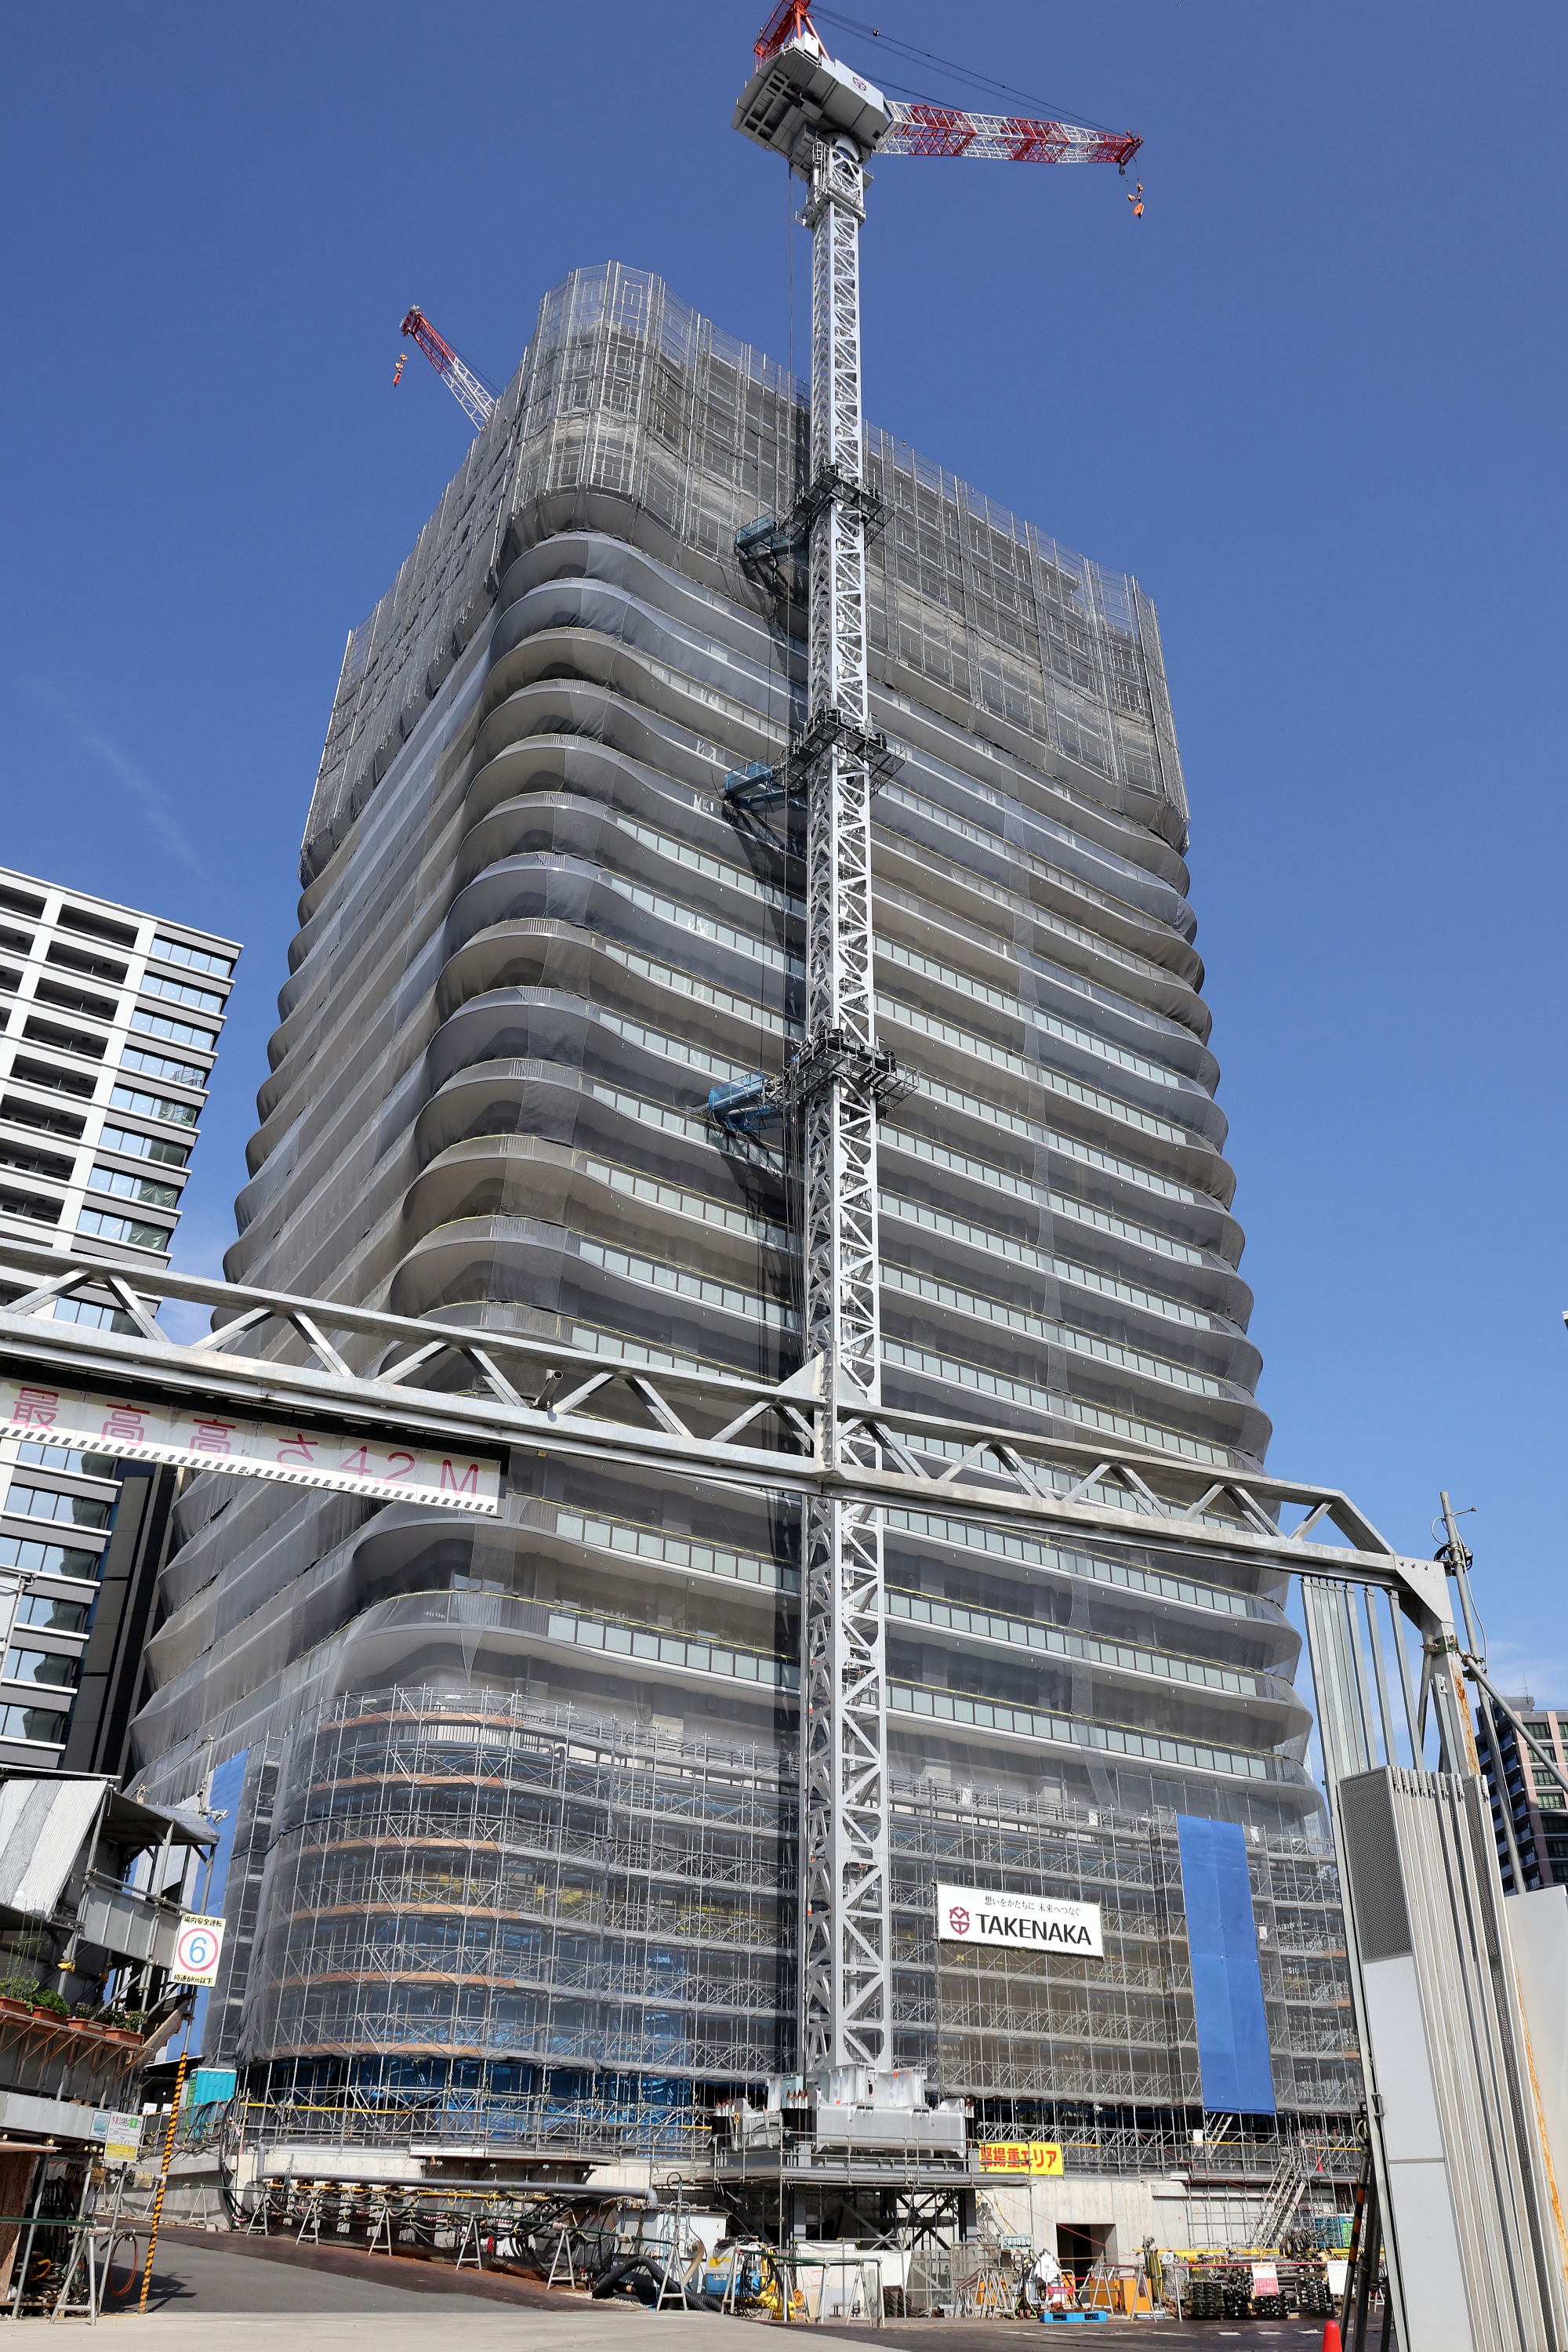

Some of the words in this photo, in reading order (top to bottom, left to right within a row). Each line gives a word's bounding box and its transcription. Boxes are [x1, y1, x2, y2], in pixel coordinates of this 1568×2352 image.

[984, 1895, 1035, 1911] 想いをかたちに
[1038, 1902, 1081, 1917] 未来へつなぐ
[183, 1916, 223, 1927] 場内安全運転
[975, 1913, 1092, 1946] TAKENAKA
[189, 1936, 207, 1964] 6
